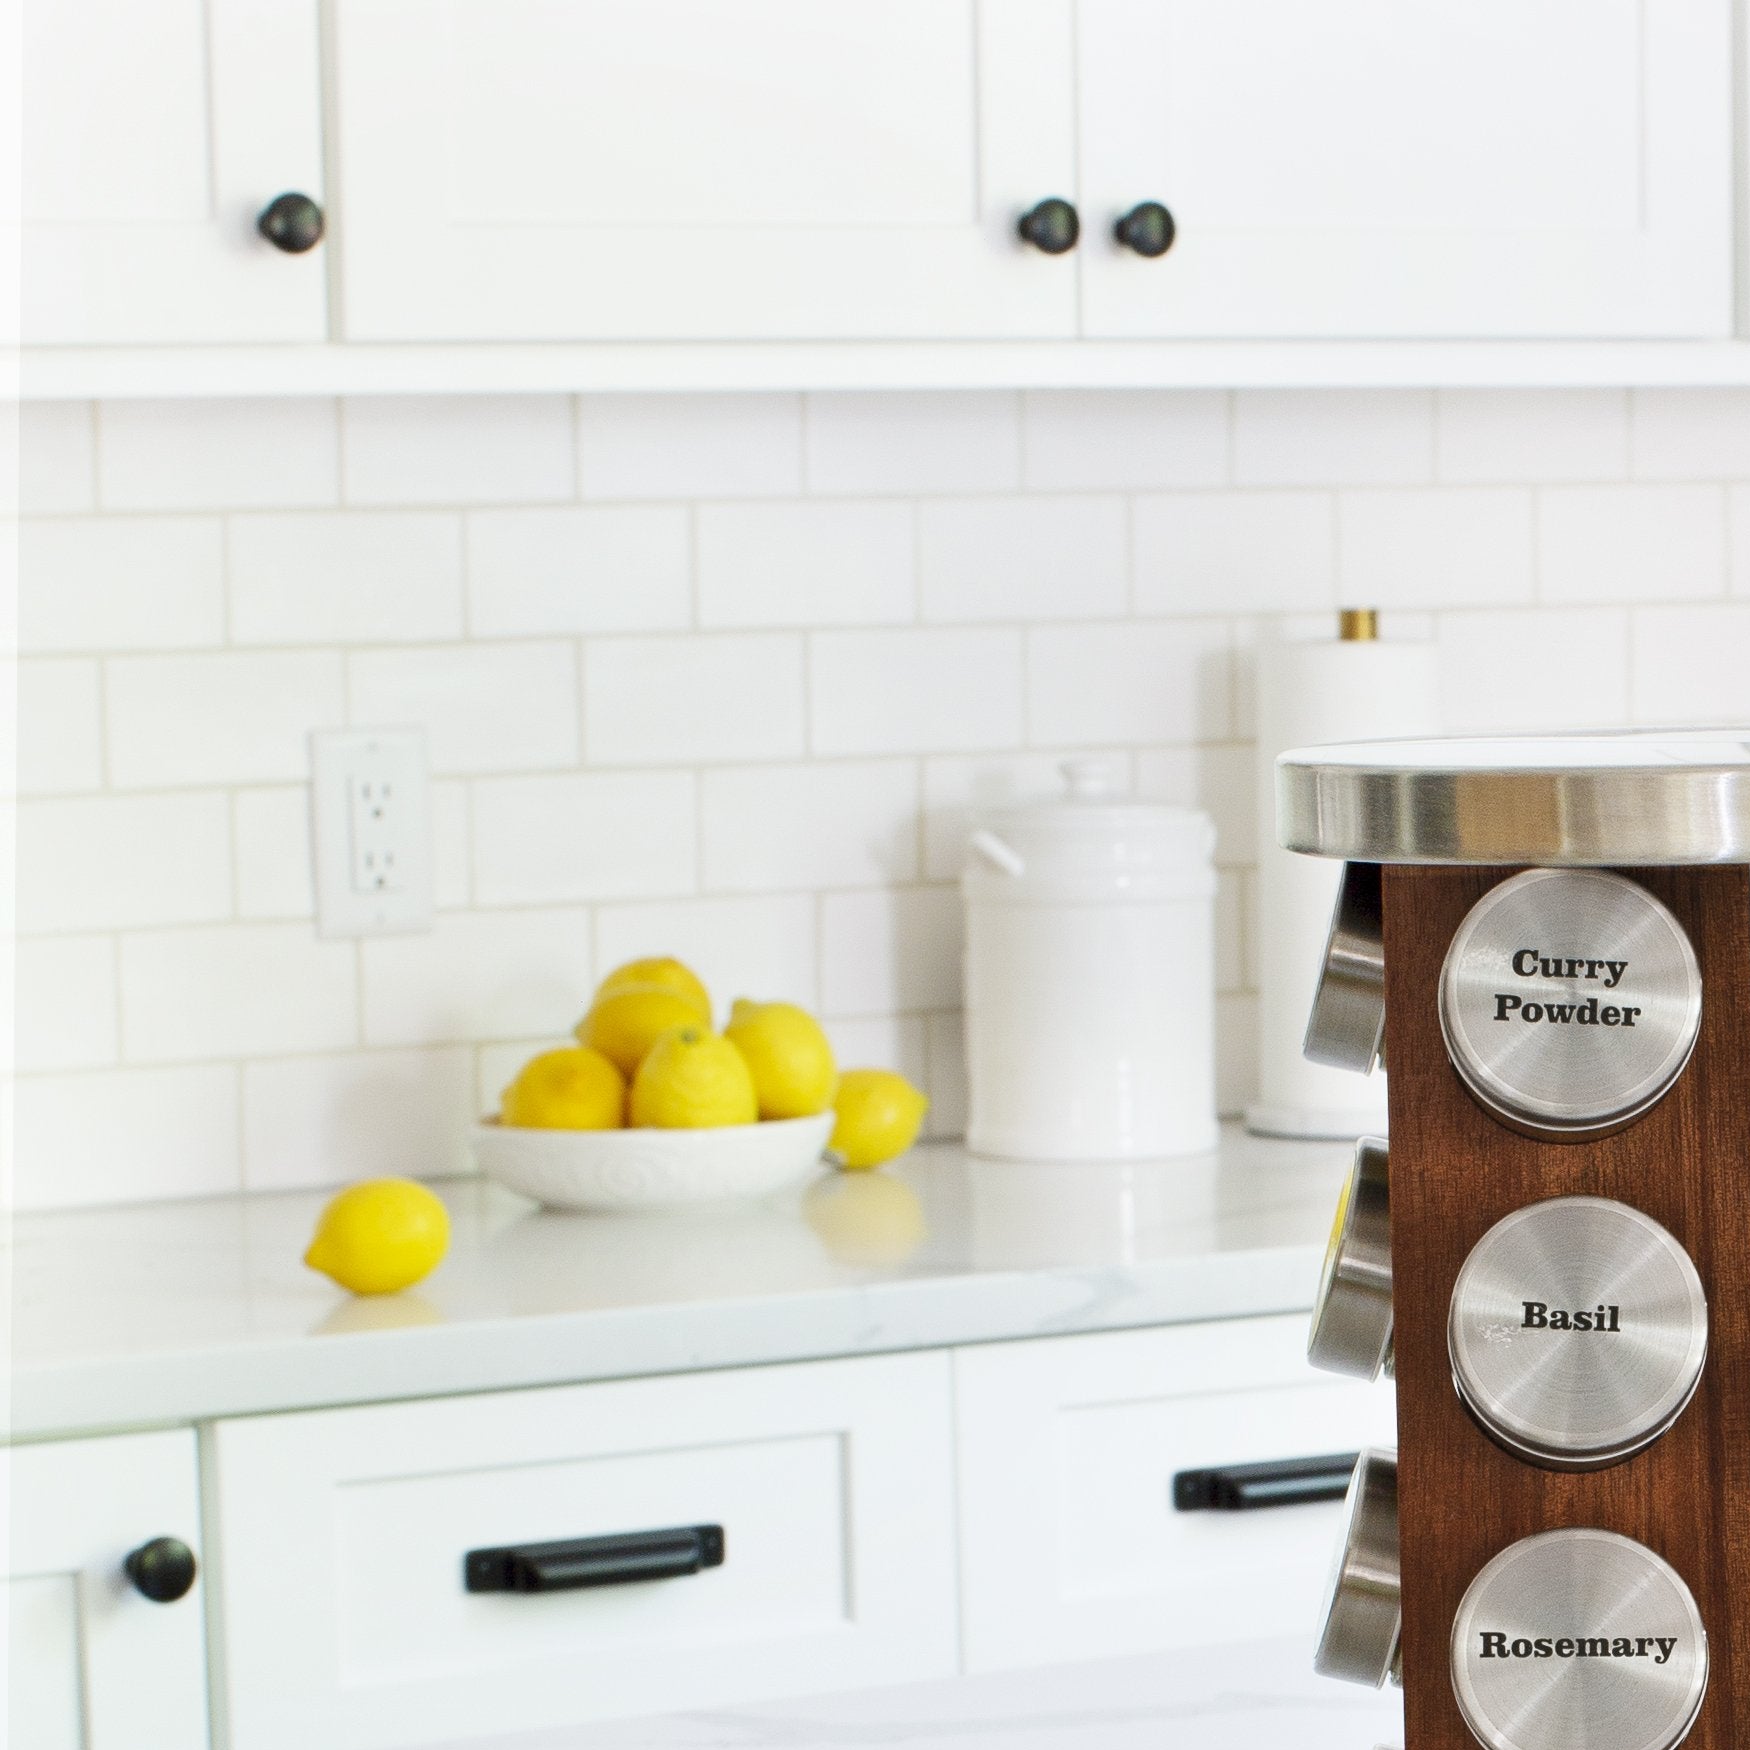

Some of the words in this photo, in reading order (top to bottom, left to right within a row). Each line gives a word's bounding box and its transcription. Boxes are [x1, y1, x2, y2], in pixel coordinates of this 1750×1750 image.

[1512, 949, 1629, 990] Curry
[1493, 993, 1642, 1028] Powder
[1520, 1301, 1621, 1332] Basil
[1479, 1632, 1678, 1665] Rosemary
